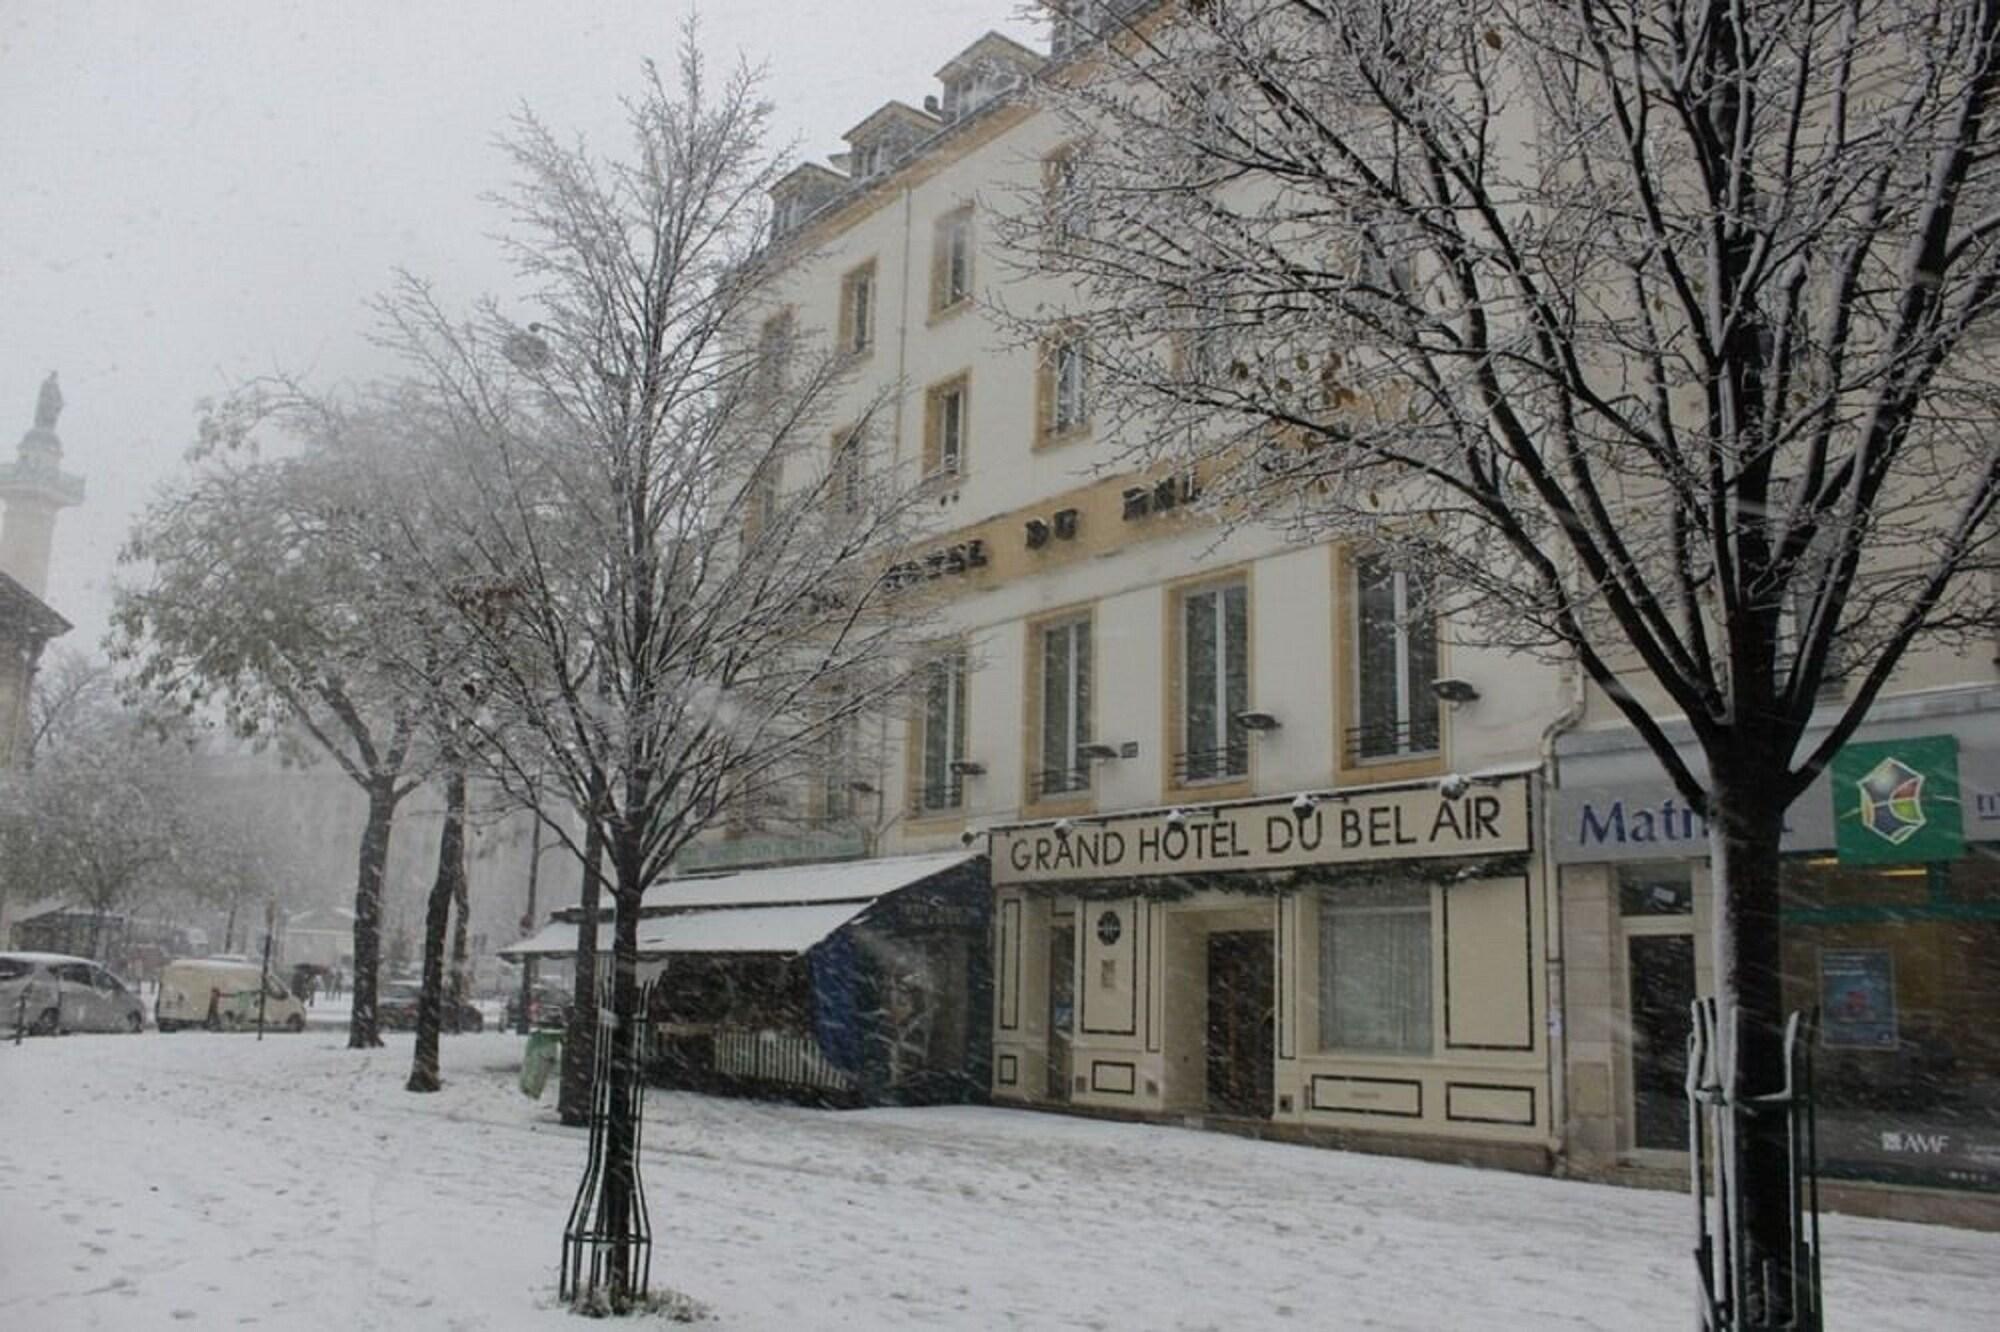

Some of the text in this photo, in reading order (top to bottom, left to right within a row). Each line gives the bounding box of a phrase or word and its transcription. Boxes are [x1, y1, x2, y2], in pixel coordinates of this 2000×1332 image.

[1011, 831, 1125, 870] GRAND
[1266, 811, 1322, 853] DU
[1341, 805, 1417, 848] BEL
[1429, 796, 1501, 842] AIR
